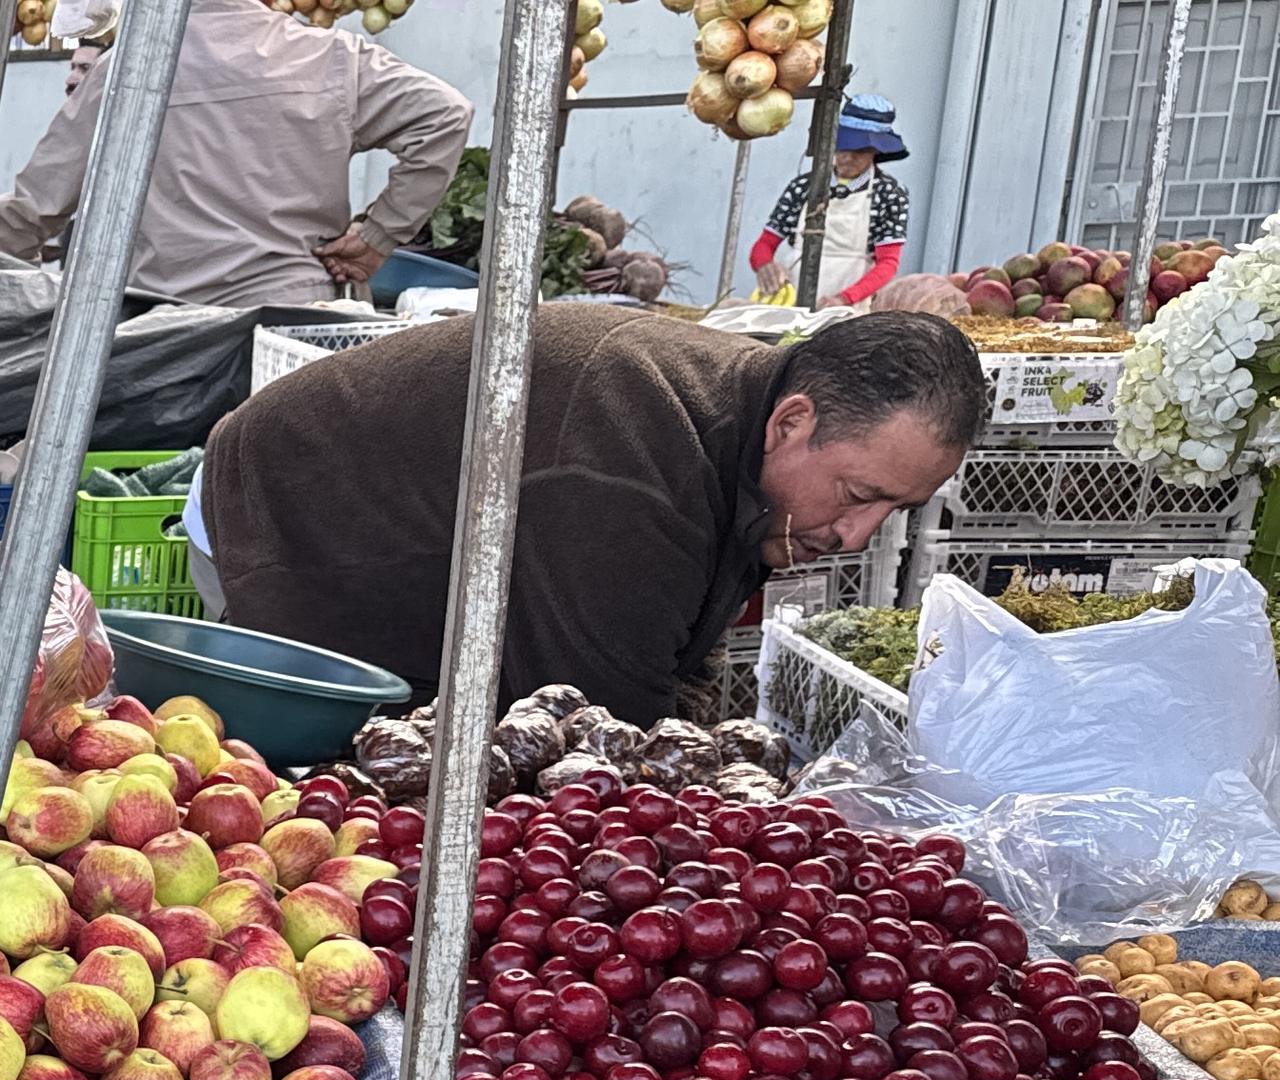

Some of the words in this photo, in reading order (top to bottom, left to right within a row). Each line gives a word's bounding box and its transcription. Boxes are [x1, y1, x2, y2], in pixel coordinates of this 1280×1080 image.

[1024, 366, 1052, 376] INKA
[1022, 376, 1066, 386] SELECT
[1021, 387, 1054, 397] FRUIT
